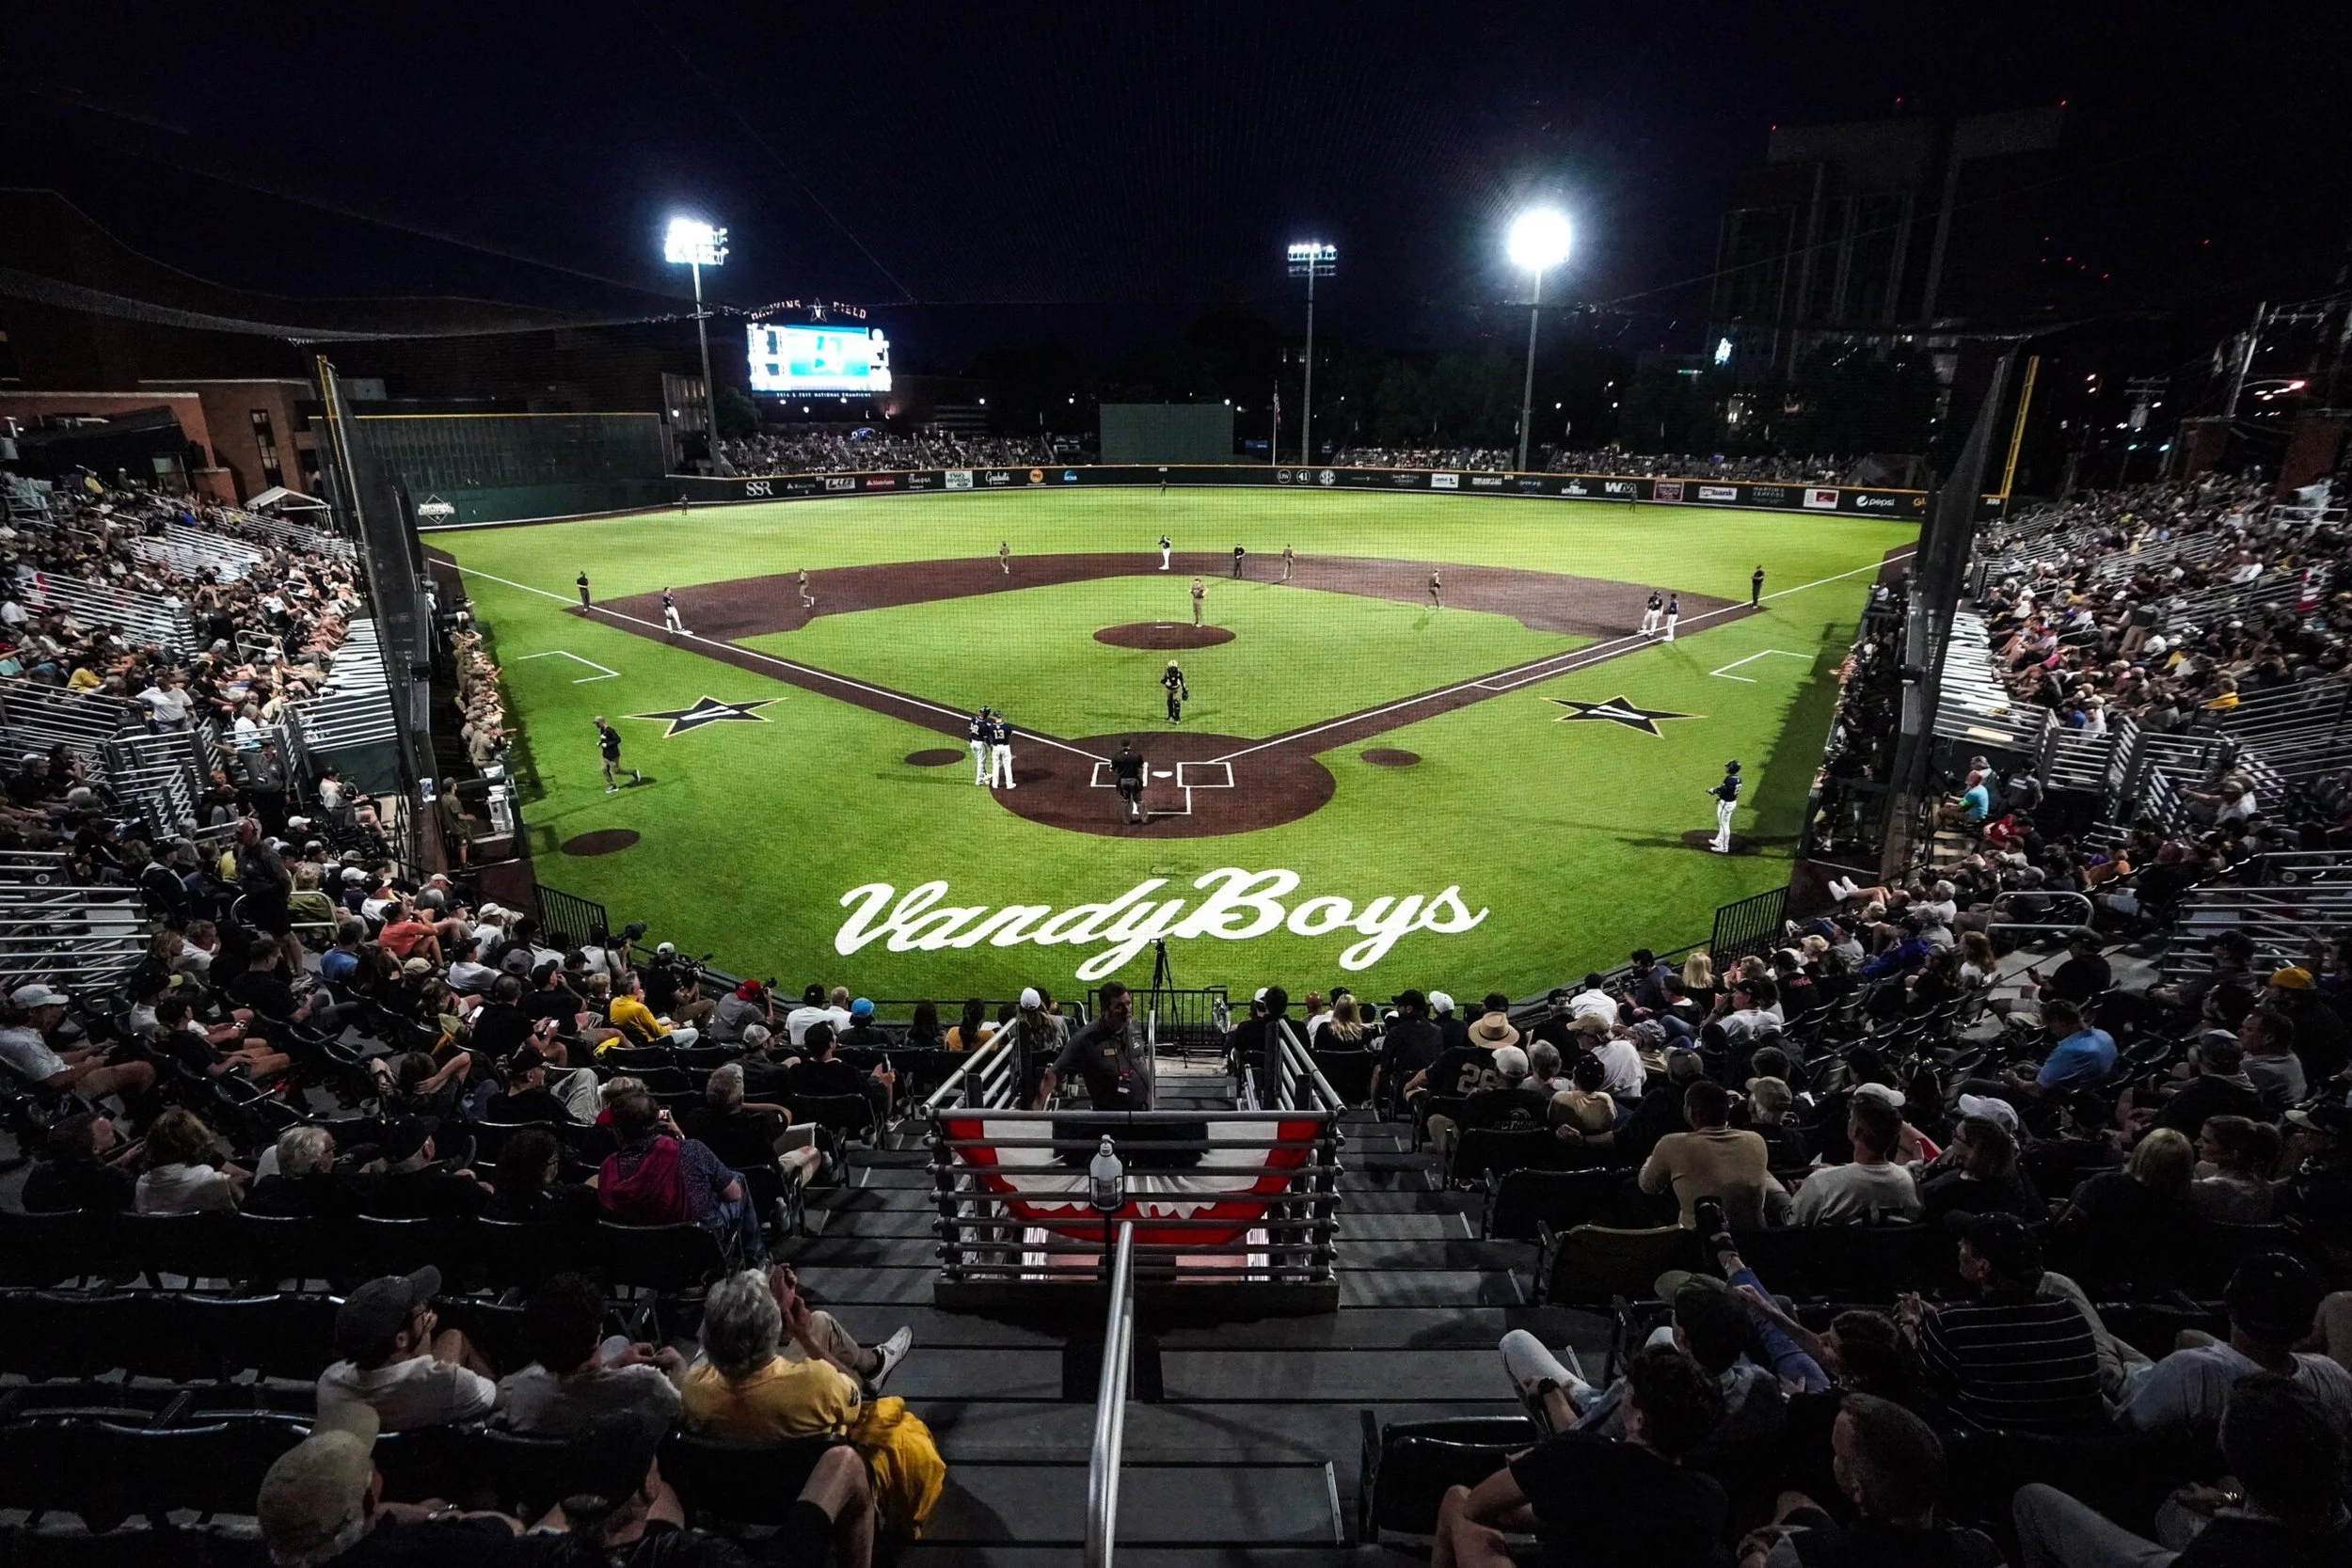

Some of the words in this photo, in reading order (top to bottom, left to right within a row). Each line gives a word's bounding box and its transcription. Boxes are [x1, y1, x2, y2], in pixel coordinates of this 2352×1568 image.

[1298, 472, 1308, 481] 41
[746, 481, 773, 497] SSR
[1605, 482, 1637, 493] WM
[1868, 498, 1896, 507] pepsi
[993, 729, 1005, 739] 13
[834, 867, 1490, 980] VandyBoys
